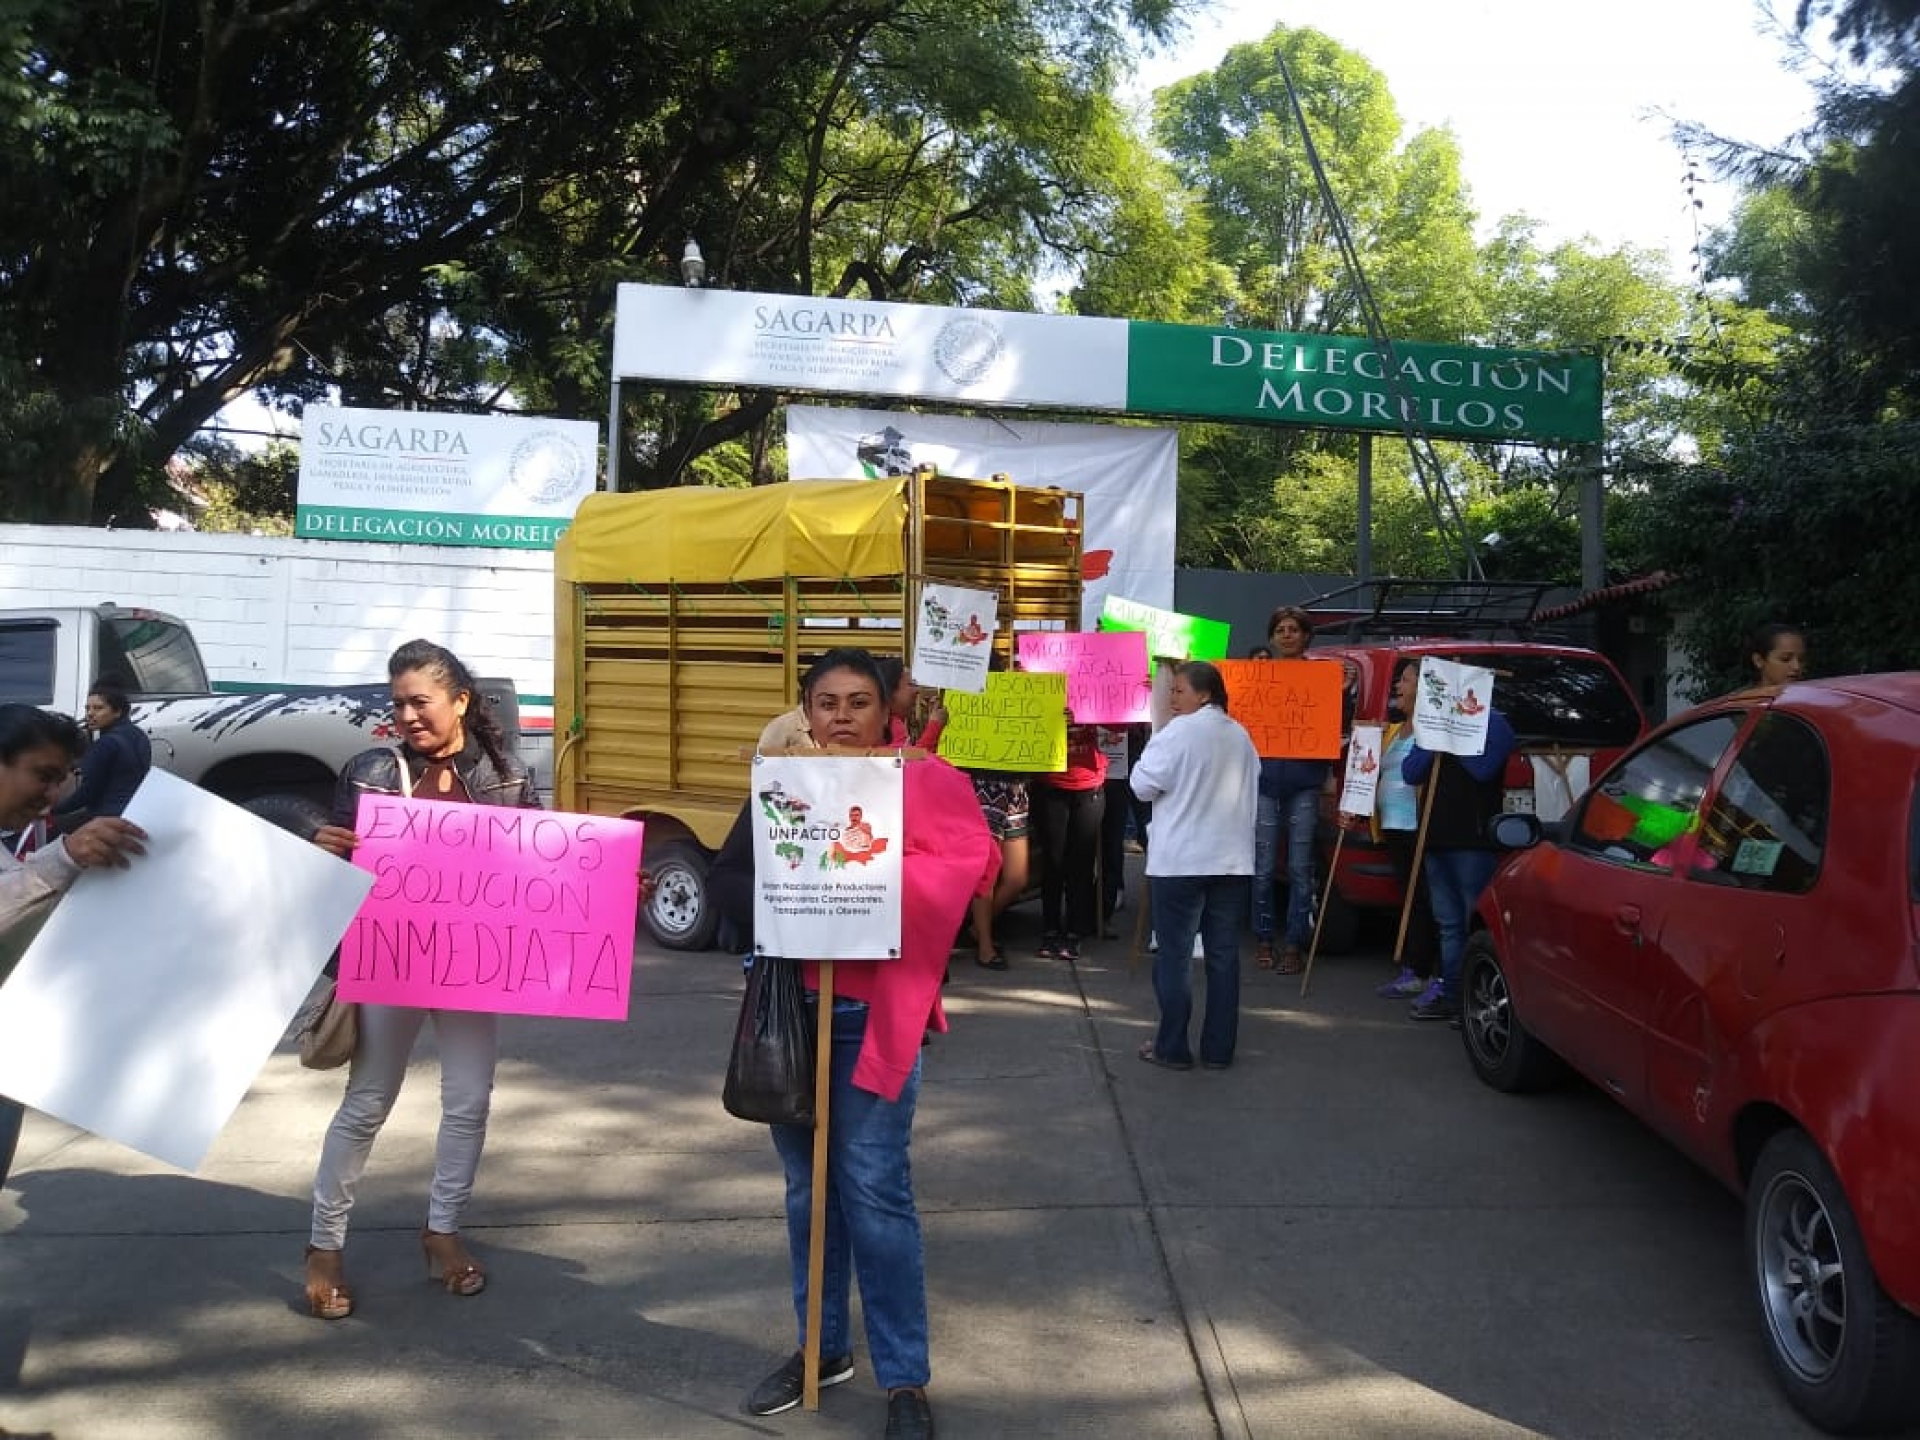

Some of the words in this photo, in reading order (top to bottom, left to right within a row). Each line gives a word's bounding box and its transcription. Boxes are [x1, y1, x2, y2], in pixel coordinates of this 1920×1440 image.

[754, 306, 895, 338] SAGARPA
[1211, 334, 1572, 396] DELEGACIÓN
[1255, 378, 1526, 431] MORELOS
[318, 421, 470, 455] SAGARPA
[305, 513, 463, 539] DELEGACIÓN
[472, 523, 569, 543] MORELO
[1025, 640, 1093, 659] MIGUEL
[986, 674, 1046, 694] USCAS
[1225, 663, 1282, 684] IGUEL
[1234, 686, 1317, 710] ZAGAL
[1278, 708, 1305, 725] UN
[365, 806, 603, 871] EXIGIMOS
[769, 826, 841, 841] UNPACTO
[371, 853, 591, 922] SOLUCIÓN
[353, 916, 620, 1001] INMEDIATA
